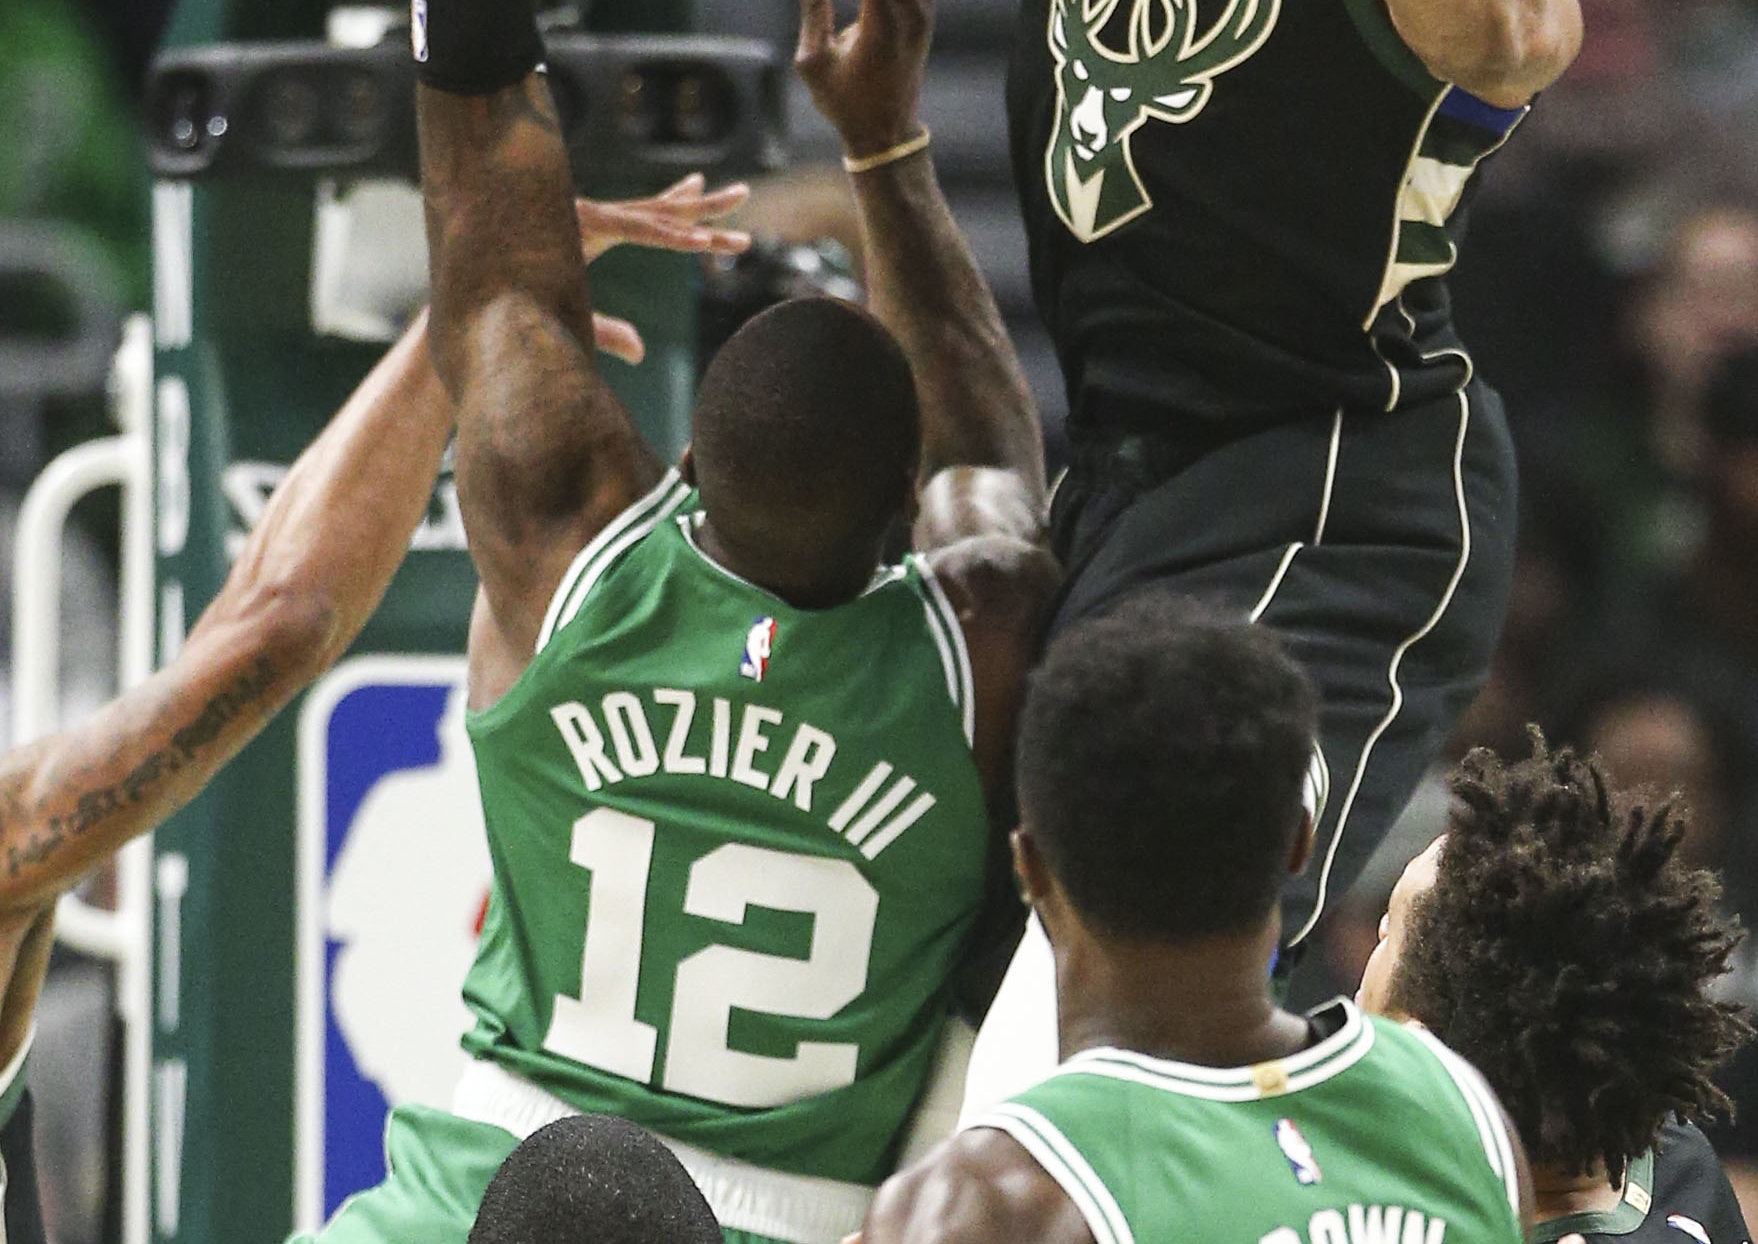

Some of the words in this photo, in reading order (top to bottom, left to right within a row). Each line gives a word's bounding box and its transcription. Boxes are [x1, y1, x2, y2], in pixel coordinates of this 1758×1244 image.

[550, 688, 837, 812] ROZIER
[827, 760, 937, 861] III
[541, 806, 880, 1108] 12
